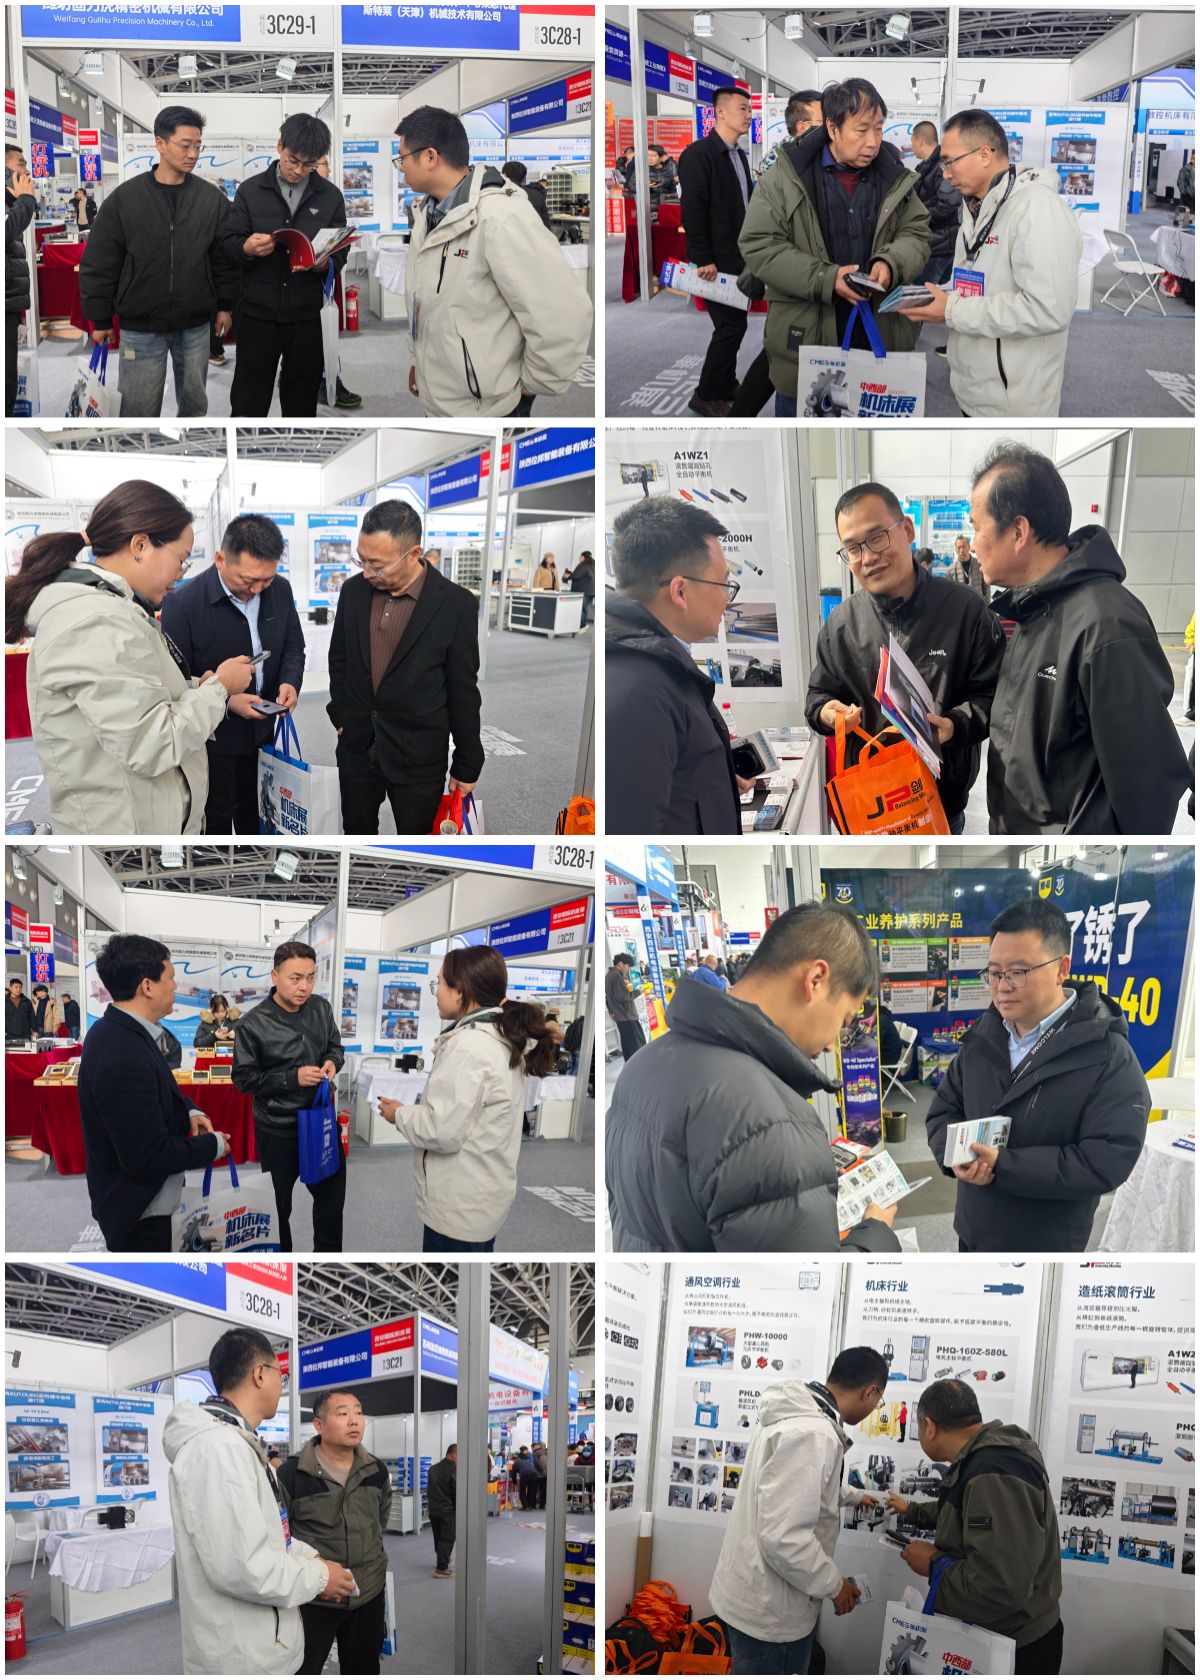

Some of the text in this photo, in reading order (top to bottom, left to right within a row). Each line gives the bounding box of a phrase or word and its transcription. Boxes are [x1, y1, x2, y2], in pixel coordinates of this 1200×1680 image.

[53, 15, 86, 24] Weifang
[112, 17, 145, 25] Precision
[147, 18, 184, 26] Machinery
[267, 14, 316, 34] 3C29-1
[540, 26, 580, 45] 3C28-1
[32, 144, 48, 177] 打标机
[84, 155, 97, 180] 打标机
[859, 392, 917, 413] 机床展
[674, 451, 709, 460] A1WZ1
[718, 534, 753, 543] -2000H
[281, 796, 308, 823] 机床展
[554, 845, 595, 870] 3C28-1
[856, 912, 963, 930] 业养护系列产品
[35, 953, 49, 982] 打标机
[225, 1212, 272, 1235] 机床展
[224, 1227, 271, 1250] 新名片
[685, 1276, 741, 1288] 通风空调行业
[865, 1280, 908, 1292] 机床行业
[1078, 1285, 1156, 1299] 造纸滚筒行业
[246, 1292, 280, 1320] 3C28-1
[744, 1332, 788, 1341] PHW-10000
[936, 1346, 1008, 1357] PHQ-160Z-580L
[942, 1652, 973, 1671] 中西部
